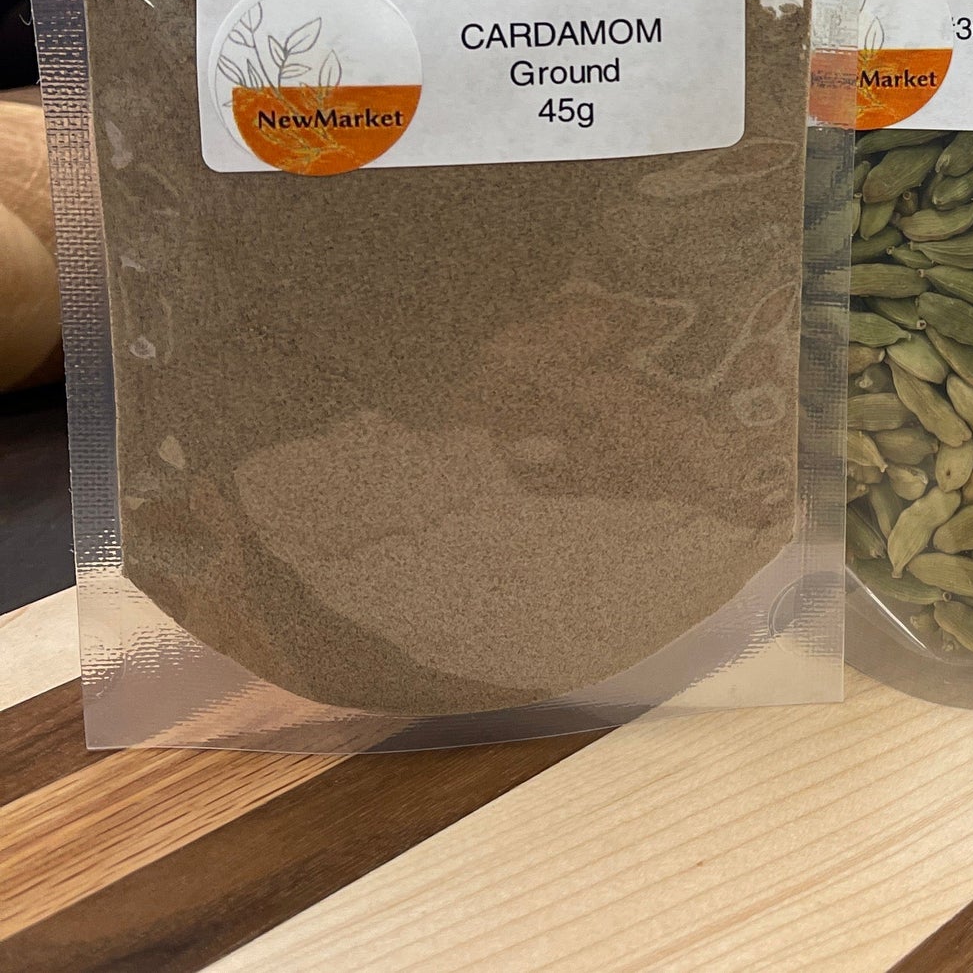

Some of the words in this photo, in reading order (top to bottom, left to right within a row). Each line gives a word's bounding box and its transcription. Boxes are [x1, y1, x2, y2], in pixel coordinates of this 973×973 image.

[460, 17, 662, 50] CARDAMOM
[510, 57, 620, 87] Ground
[812, 69, 938, 89] Market
[257, 107, 404, 130] NewMarket
[538, 97, 594, 129] 45g
